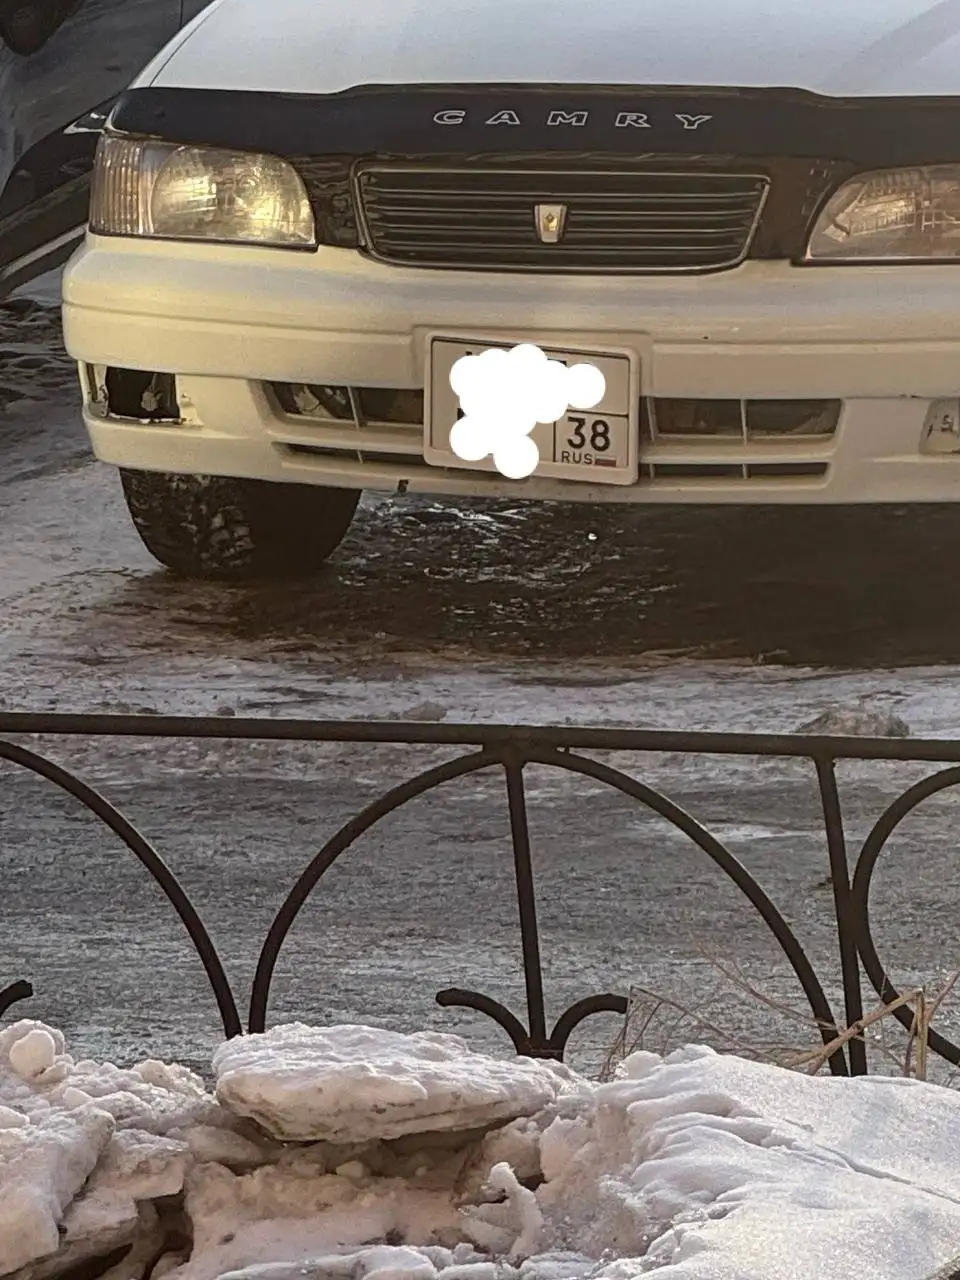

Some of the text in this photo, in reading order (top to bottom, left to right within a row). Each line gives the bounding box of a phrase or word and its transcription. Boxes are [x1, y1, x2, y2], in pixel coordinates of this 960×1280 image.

[433, 109, 713, 130] CAMRY
[567, 416, 611, 452] 38
[561, 450, 593, 465] RUS
